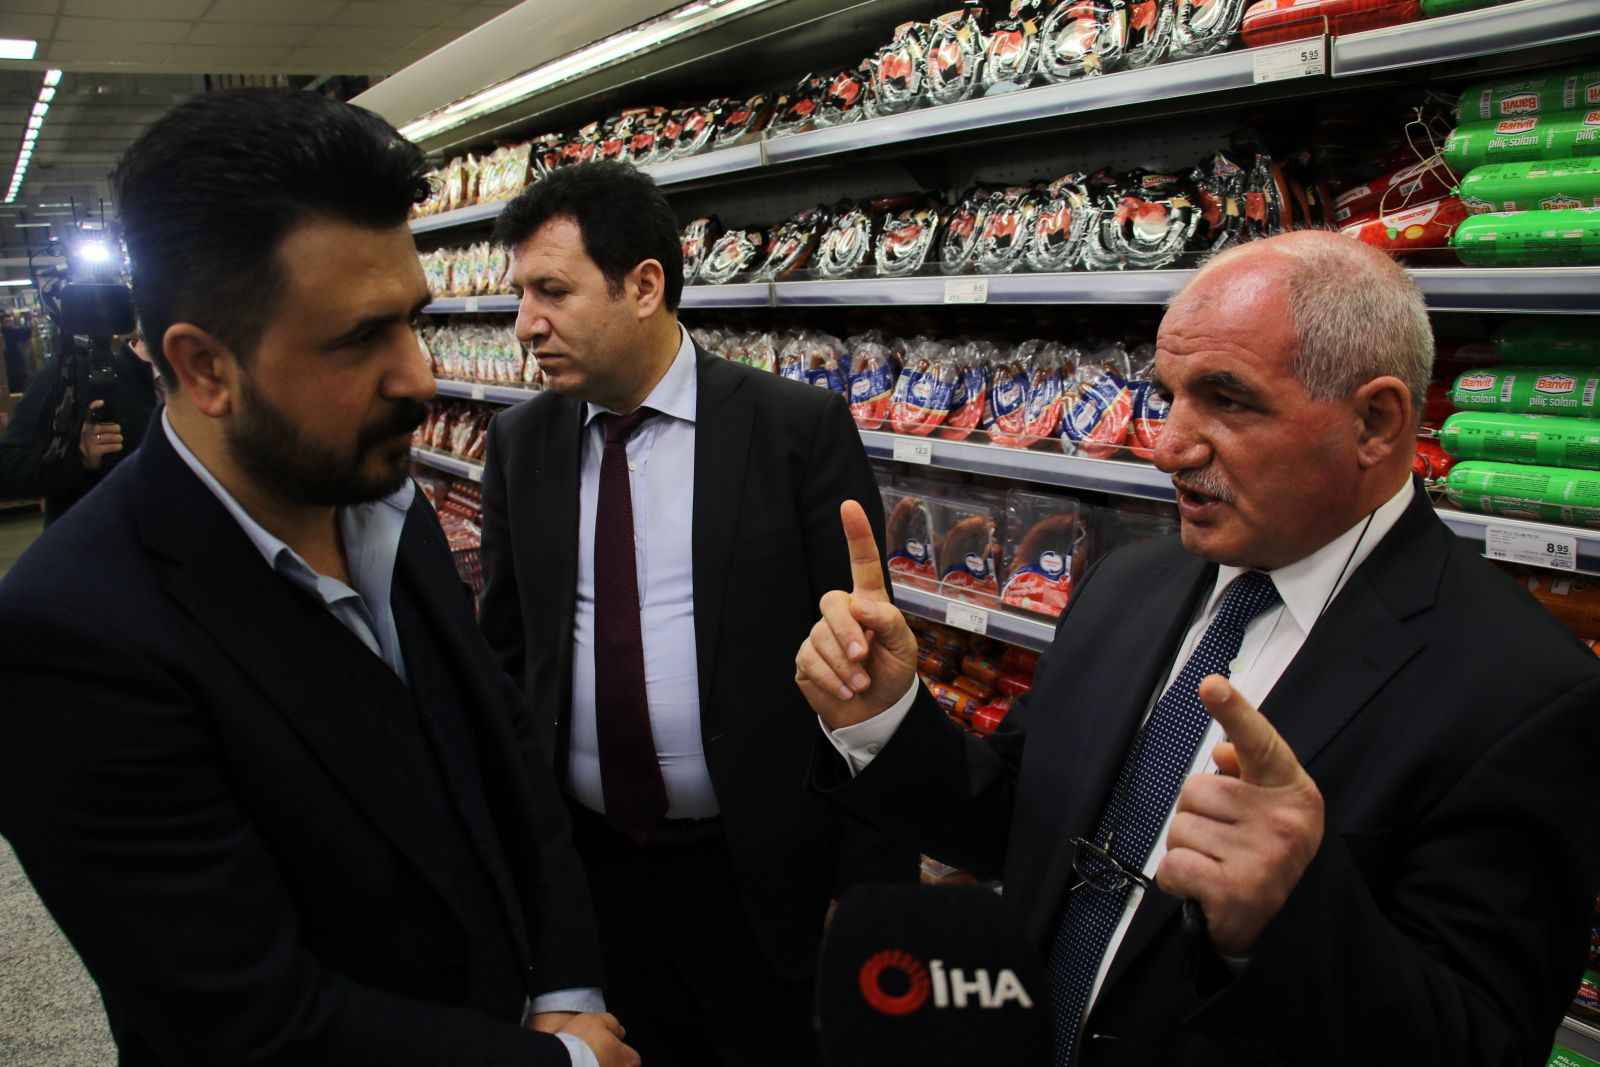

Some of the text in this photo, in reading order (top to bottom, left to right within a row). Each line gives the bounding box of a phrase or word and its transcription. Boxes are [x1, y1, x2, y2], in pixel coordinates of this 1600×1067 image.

[1502, 97, 1537, 112] Banvit
[1498, 119, 1534, 131] Banvit
[1488, 137, 1508, 150] piliç
[1509, 135, 1539, 147] salam
[1460, 378, 1492, 387] Banvit
[1537, 379, 1573, 390] Banvit
[1471, 394, 1497, 404] salam
[1529, 395, 1577, 408] piliç salam
[929, 959, 1033, 1009] İHA
